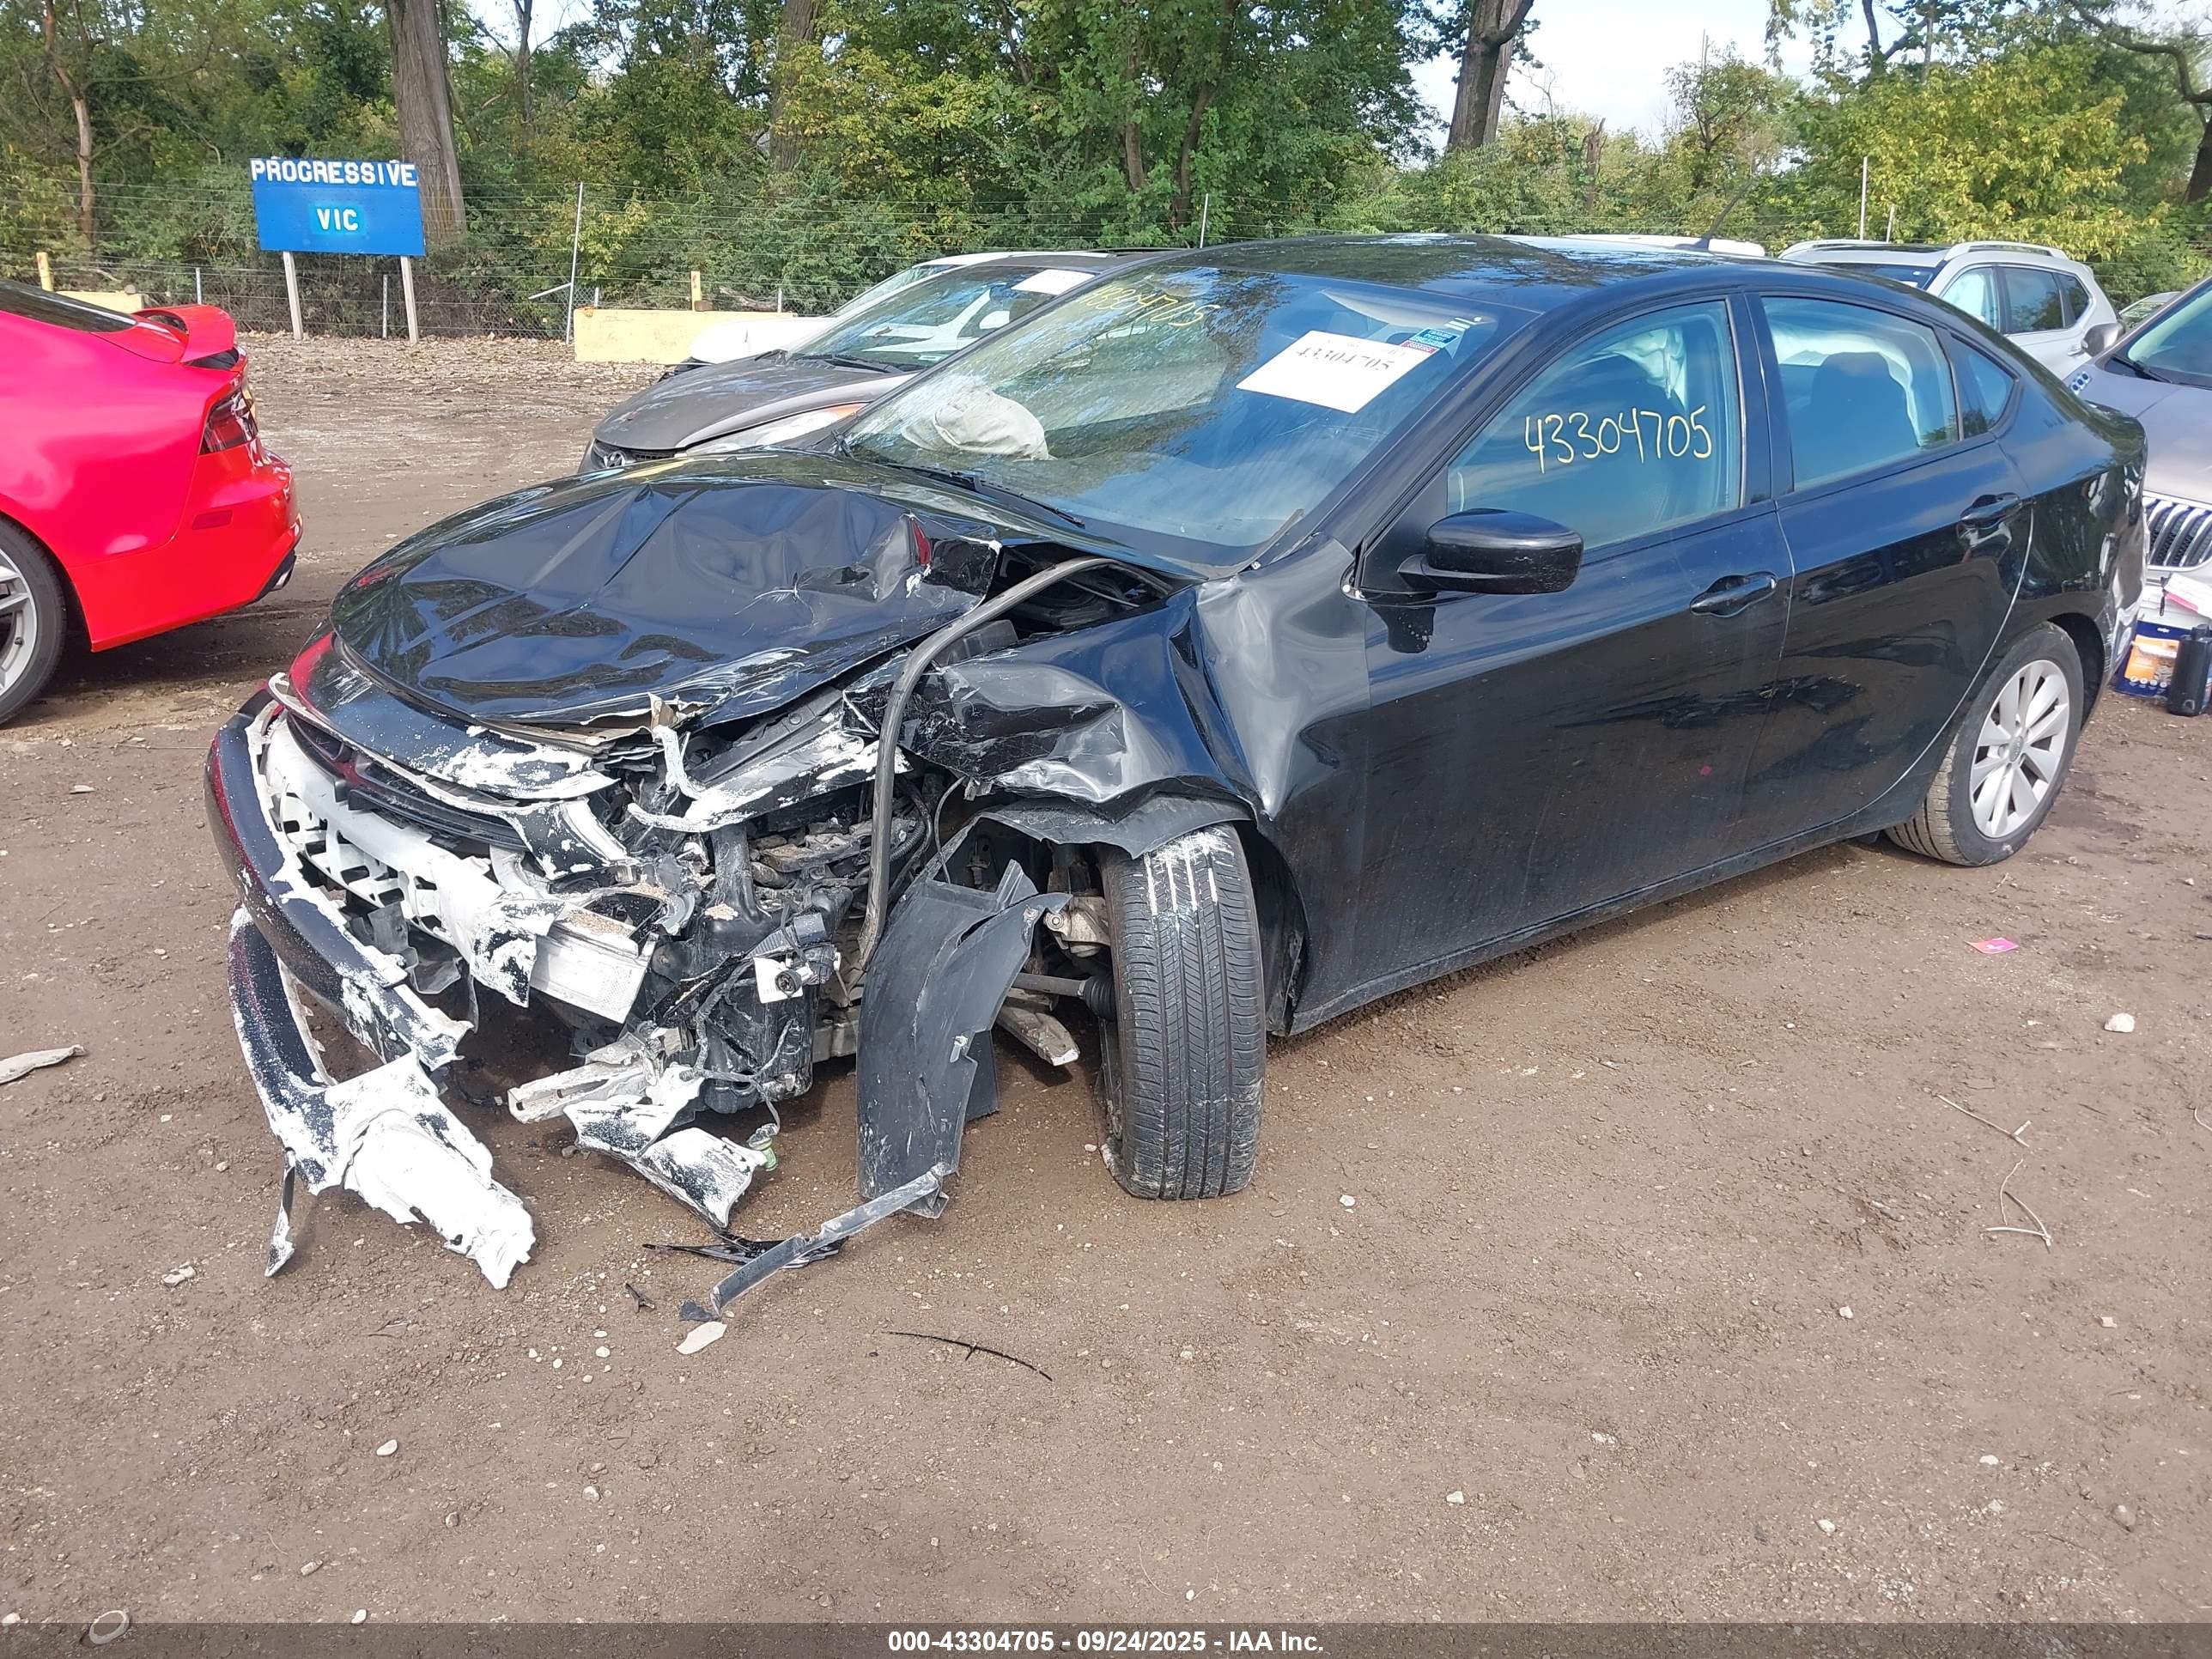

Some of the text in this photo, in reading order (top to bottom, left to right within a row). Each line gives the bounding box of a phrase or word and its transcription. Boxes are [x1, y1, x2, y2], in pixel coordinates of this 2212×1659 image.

[251, 160, 416, 186] PROGRESSIVE
[316, 208, 359, 231] VIC
[1524, 404, 1712, 475] 43304705
